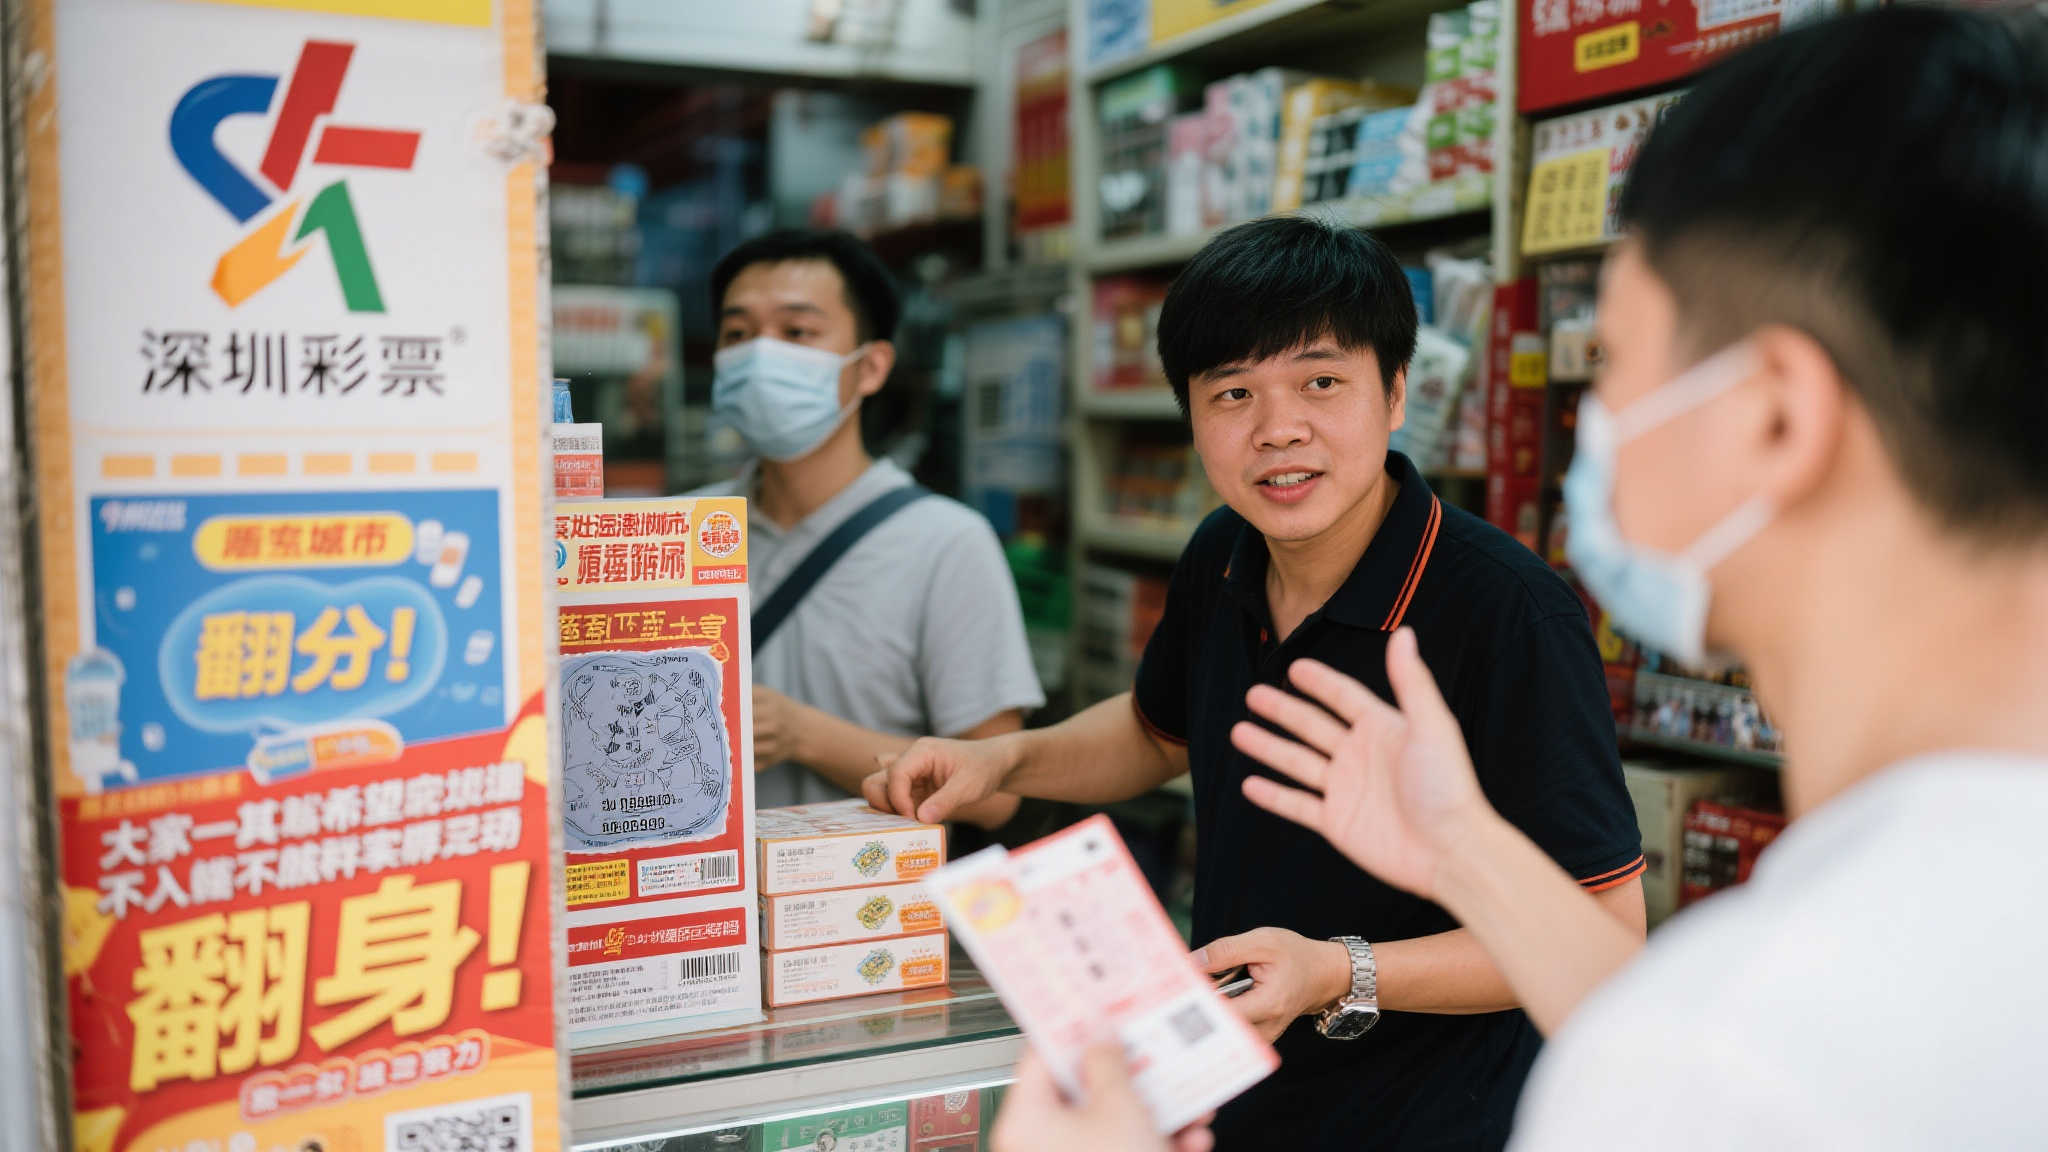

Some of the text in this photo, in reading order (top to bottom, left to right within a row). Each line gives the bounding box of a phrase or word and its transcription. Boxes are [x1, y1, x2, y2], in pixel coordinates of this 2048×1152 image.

[140, 329, 446, 397] 深圳彩票
[194, 606, 415, 699] 翻分!
[126, 860, 531, 1092] 翻身!
